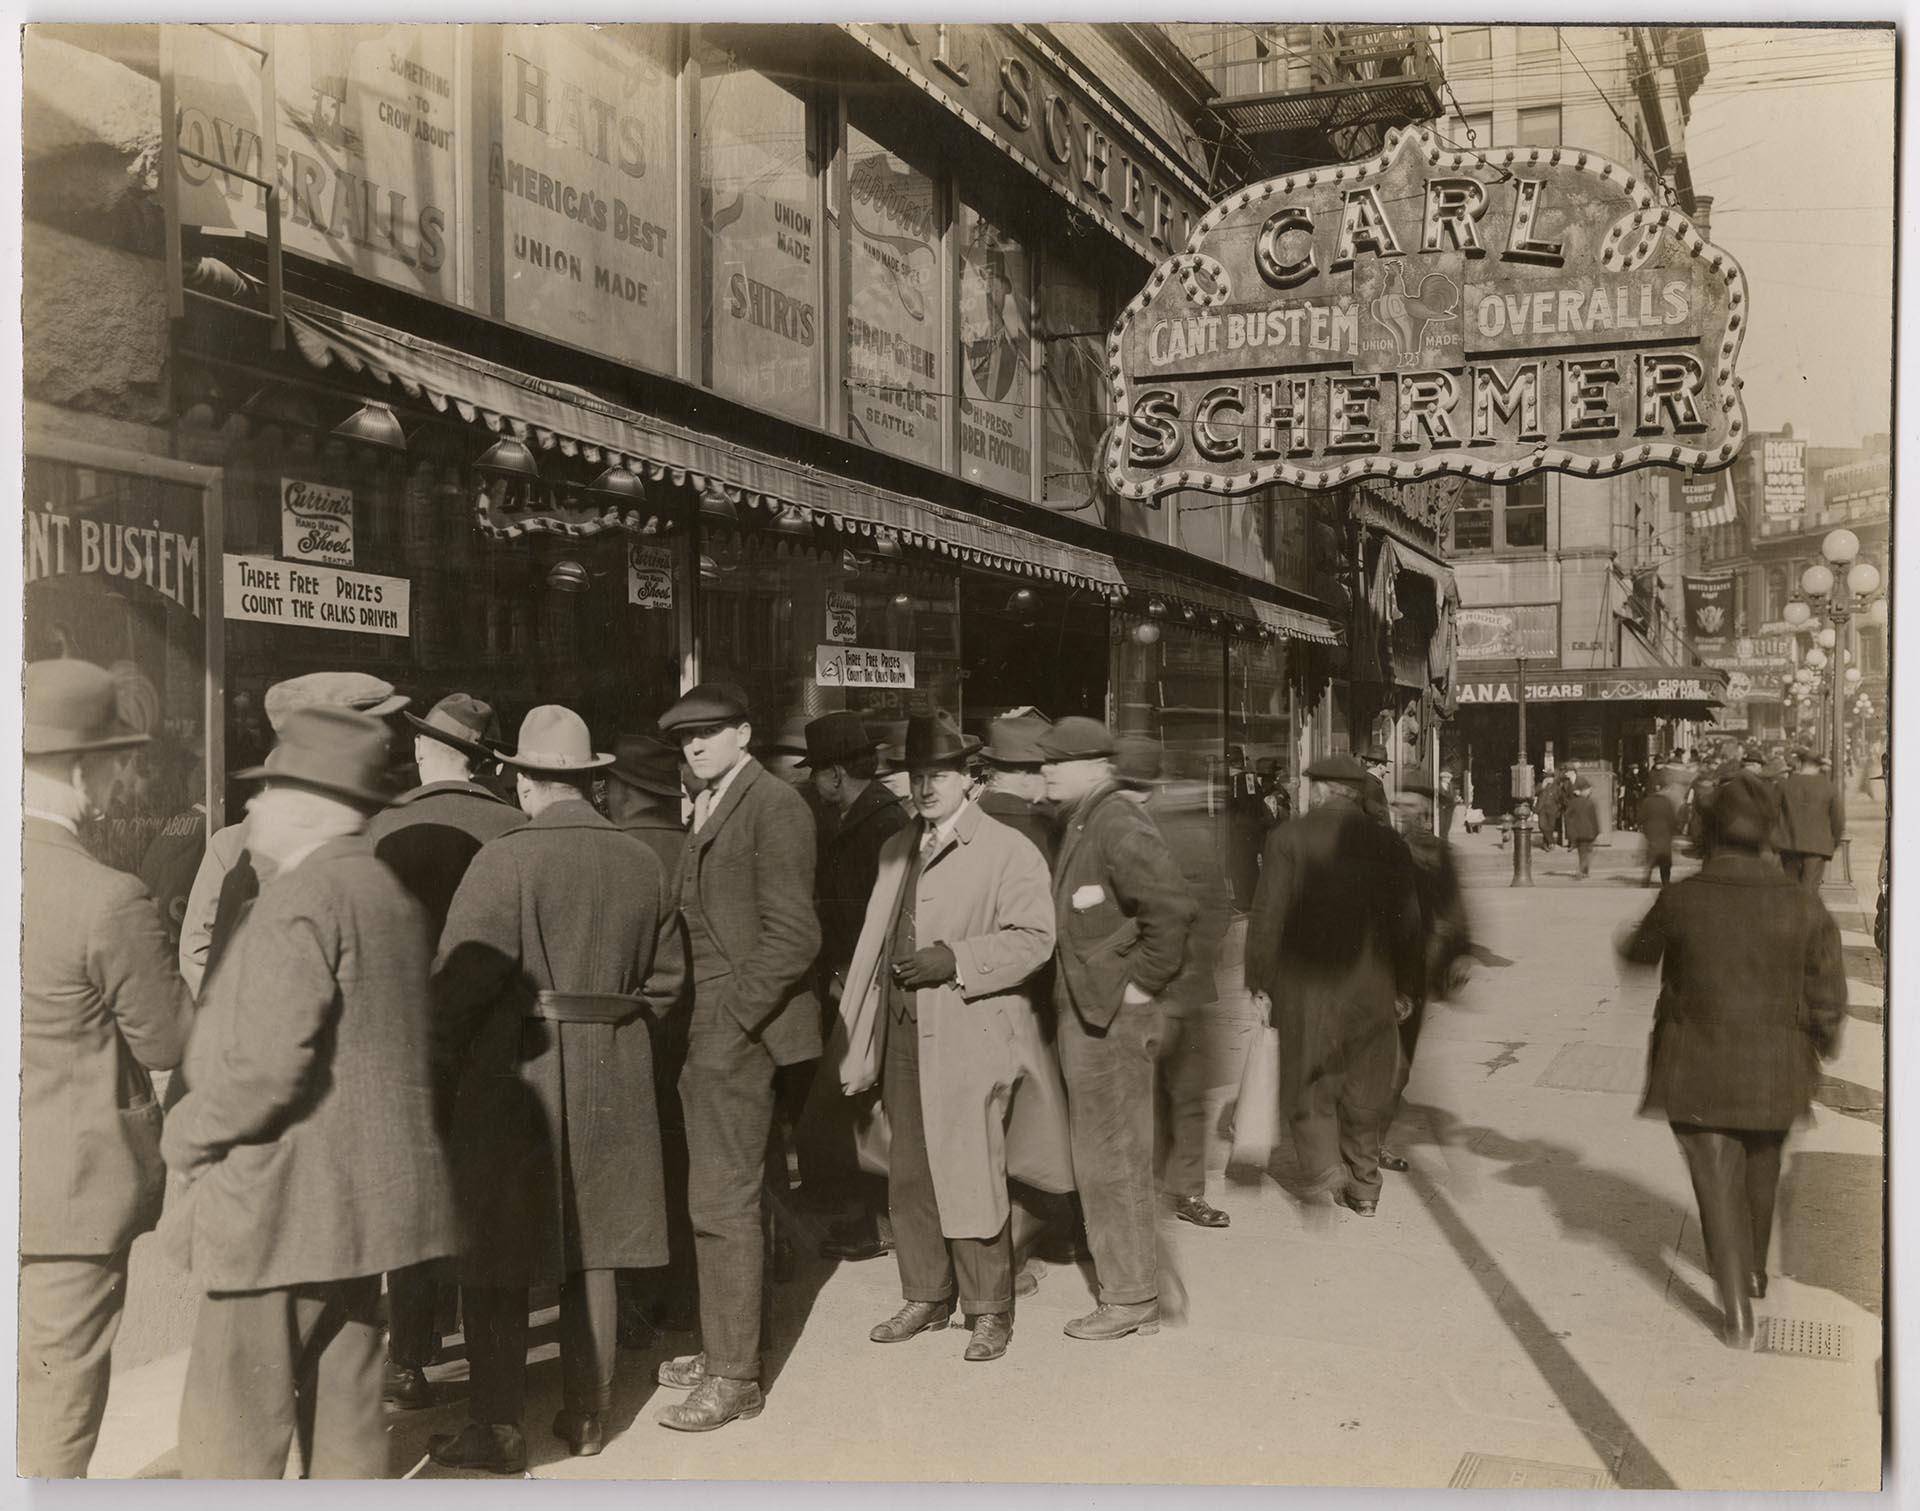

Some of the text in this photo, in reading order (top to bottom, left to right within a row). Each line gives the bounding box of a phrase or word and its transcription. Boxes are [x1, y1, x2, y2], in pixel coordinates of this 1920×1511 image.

[389, 53, 450, 99] SOMETHING
[379, 101, 411, 134] CROW
[415, 95, 430, 113] TO
[511, 52, 647, 179] HATS
[1000, 56, 1192, 254] SCHER
[488, 141, 667, 259] AMERICA'S BEST
[774, 200, 811, 238] UNION
[1255, 177, 1566, 290] CARL
[776, 231, 811, 265] MADE
[881, 252, 900, 272] MADE
[513, 233, 648, 307] UNION MADE
[730, 272, 815, 347] SHIRTS
[1478, 280, 1691, 338] OVERALLS
[1362, 335, 1459, 351] UNION MADE
[866, 407, 915, 438] SEATTLE
[973, 406, 1013, 438] HI-PRESS
[1128, 351, 1705, 468] SCHERMER
[962, 422, 986, 460] BBER
[988, 433, 1031, 476] FOOTWEA
[1764, 458, 1804, 473] HOTEL
[25, 501, 71, 584] N'T
[295, 518, 340, 533] HAND MADE
[322, 556, 353, 566] SEATTLE
[238, 561, 383, 604] THREE FREE PRIZES
[241, 594, 398, 629] COUNT THE CALKS DRIVEN
[1525, 684, 1584, 699] CIGARS
[1658, 679, 1701, 689] CIGARS
[161, 815, 201, 837] ABOUT
